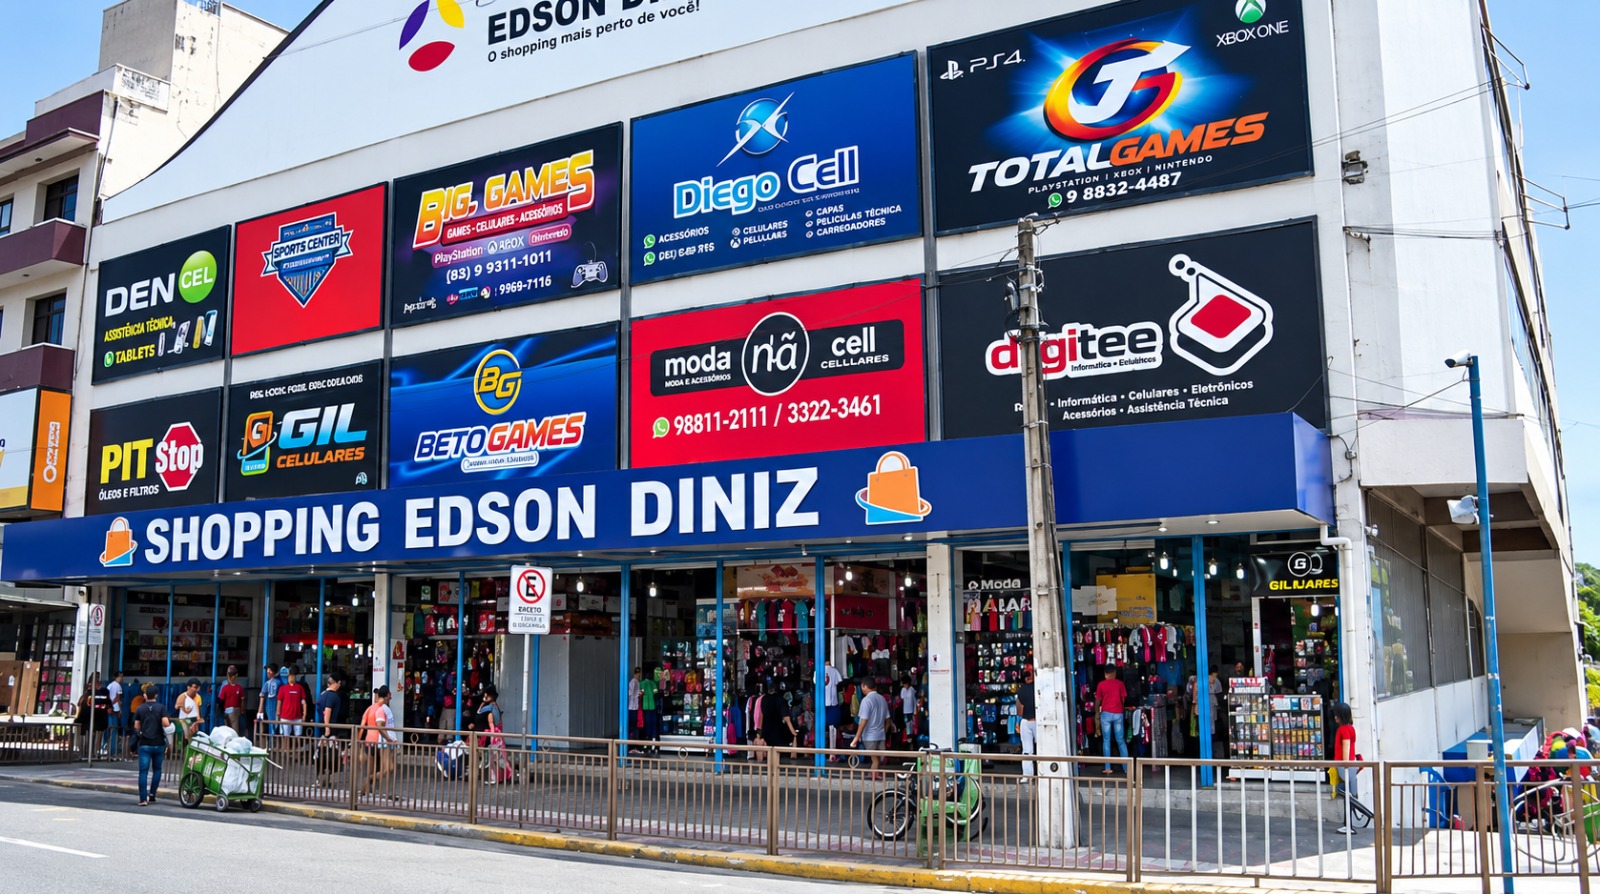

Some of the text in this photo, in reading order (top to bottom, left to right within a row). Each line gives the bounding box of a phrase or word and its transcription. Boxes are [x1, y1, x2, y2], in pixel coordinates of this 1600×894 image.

[487, 51, 497, 62] O
[500, 37, 557, 59] shopping
[561, 27, 592, 43] mais
[596, 19, 632, 37] perto
[637, 12, 655, 25] de
[488, 0, 605, 45] EDSON
[484, 150, 594, 212] GAMES
[673, 172, 780, 219] Diego
[787, 145, 860, 193] Cell
[1028, 155, 1213, 194] PLAYSTATION XBOX NINTENDO
[1066, 172, 1182, 203] 9 8832-4487
[816, 204, 844, 216] CAPAS
[274, 232, 340, 258] SPORTS CENTER
[658, 226, 710, 243] ACESSÓRIOS
[434, 246, 484, 265] PlayStation
[474, 264, 483, 277] 9
[486, 249, 552, 274] 9311-1011
[104, 266, 214, 318] DEN CEL
[115, 344, 155, 364] TABLETS
[831, 326, 876, 357] cell
[991, 328, 1157, 374] dgitee
[665, 346, 731, 377] moda
[1057, 393, 1118, 408] Informática
[1128, 387, 1180, 401] Celulares
[1062, 406, 1117, 421] Acessórios
[1187, 395, 1229, 409] Técnica
[278, 403, 368, 449] GIL
[673, 405, 767, 436] 98811-2111
[787, 394, 881, 424] 3322-3461
[100, 438, 154, 484] PIT
[155, 440, 204, 475] Stop
[276, 447, 365, 469] CELULARES
[99, 484, 160, 501] ÓLEOS E FILTROS
[144, 466, 820, 564] SHOPPING EDSON DINIZ
[981, 578, 1021, 590] Moda
